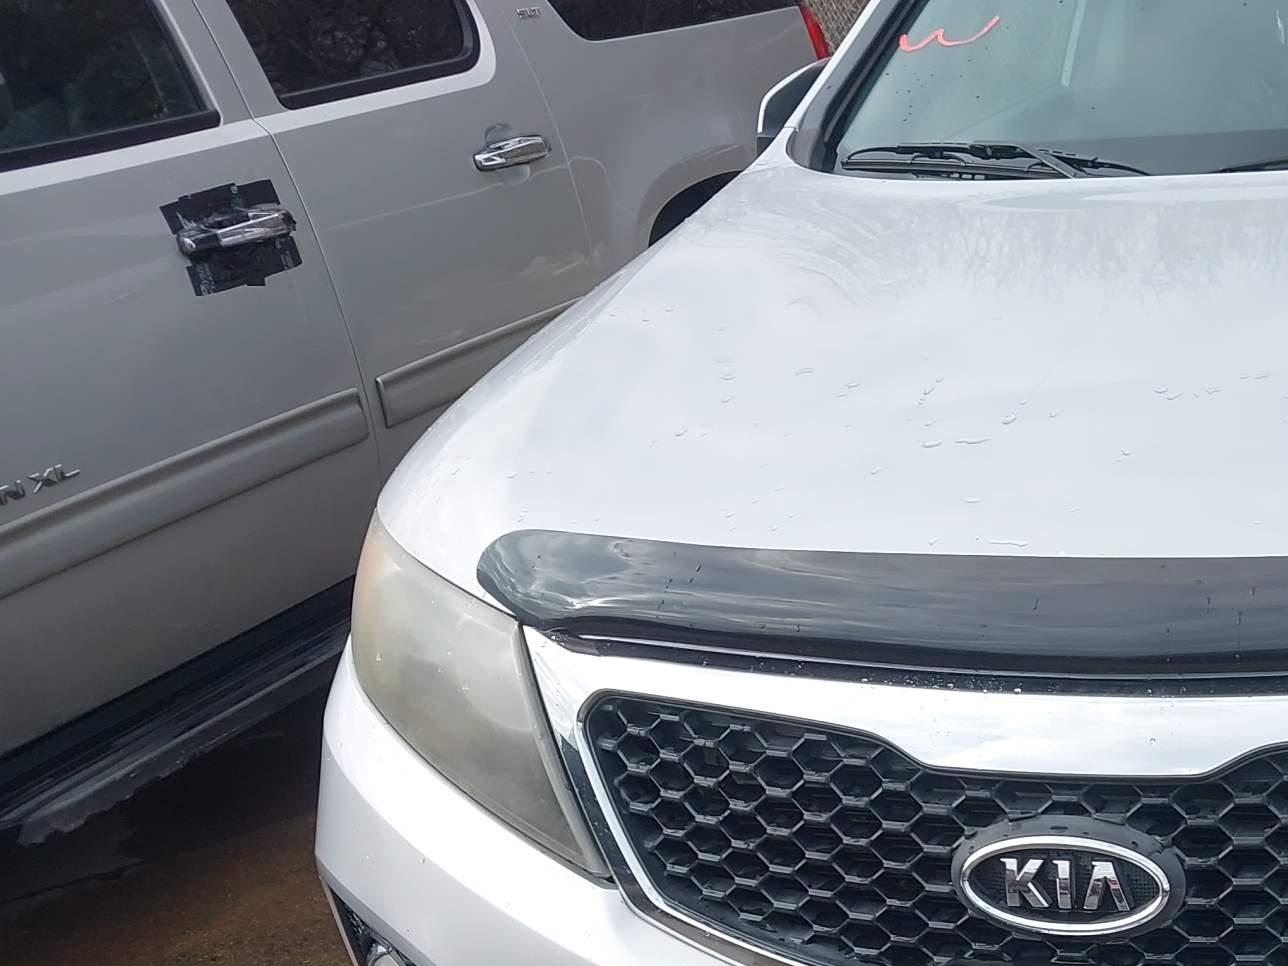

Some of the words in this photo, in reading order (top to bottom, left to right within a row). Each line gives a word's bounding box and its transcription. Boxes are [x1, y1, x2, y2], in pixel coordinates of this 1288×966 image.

[515, 6, 542, 20] SLT
[27, 463, 81, 494] XL
[999, 857, 1131, 912] KIA
